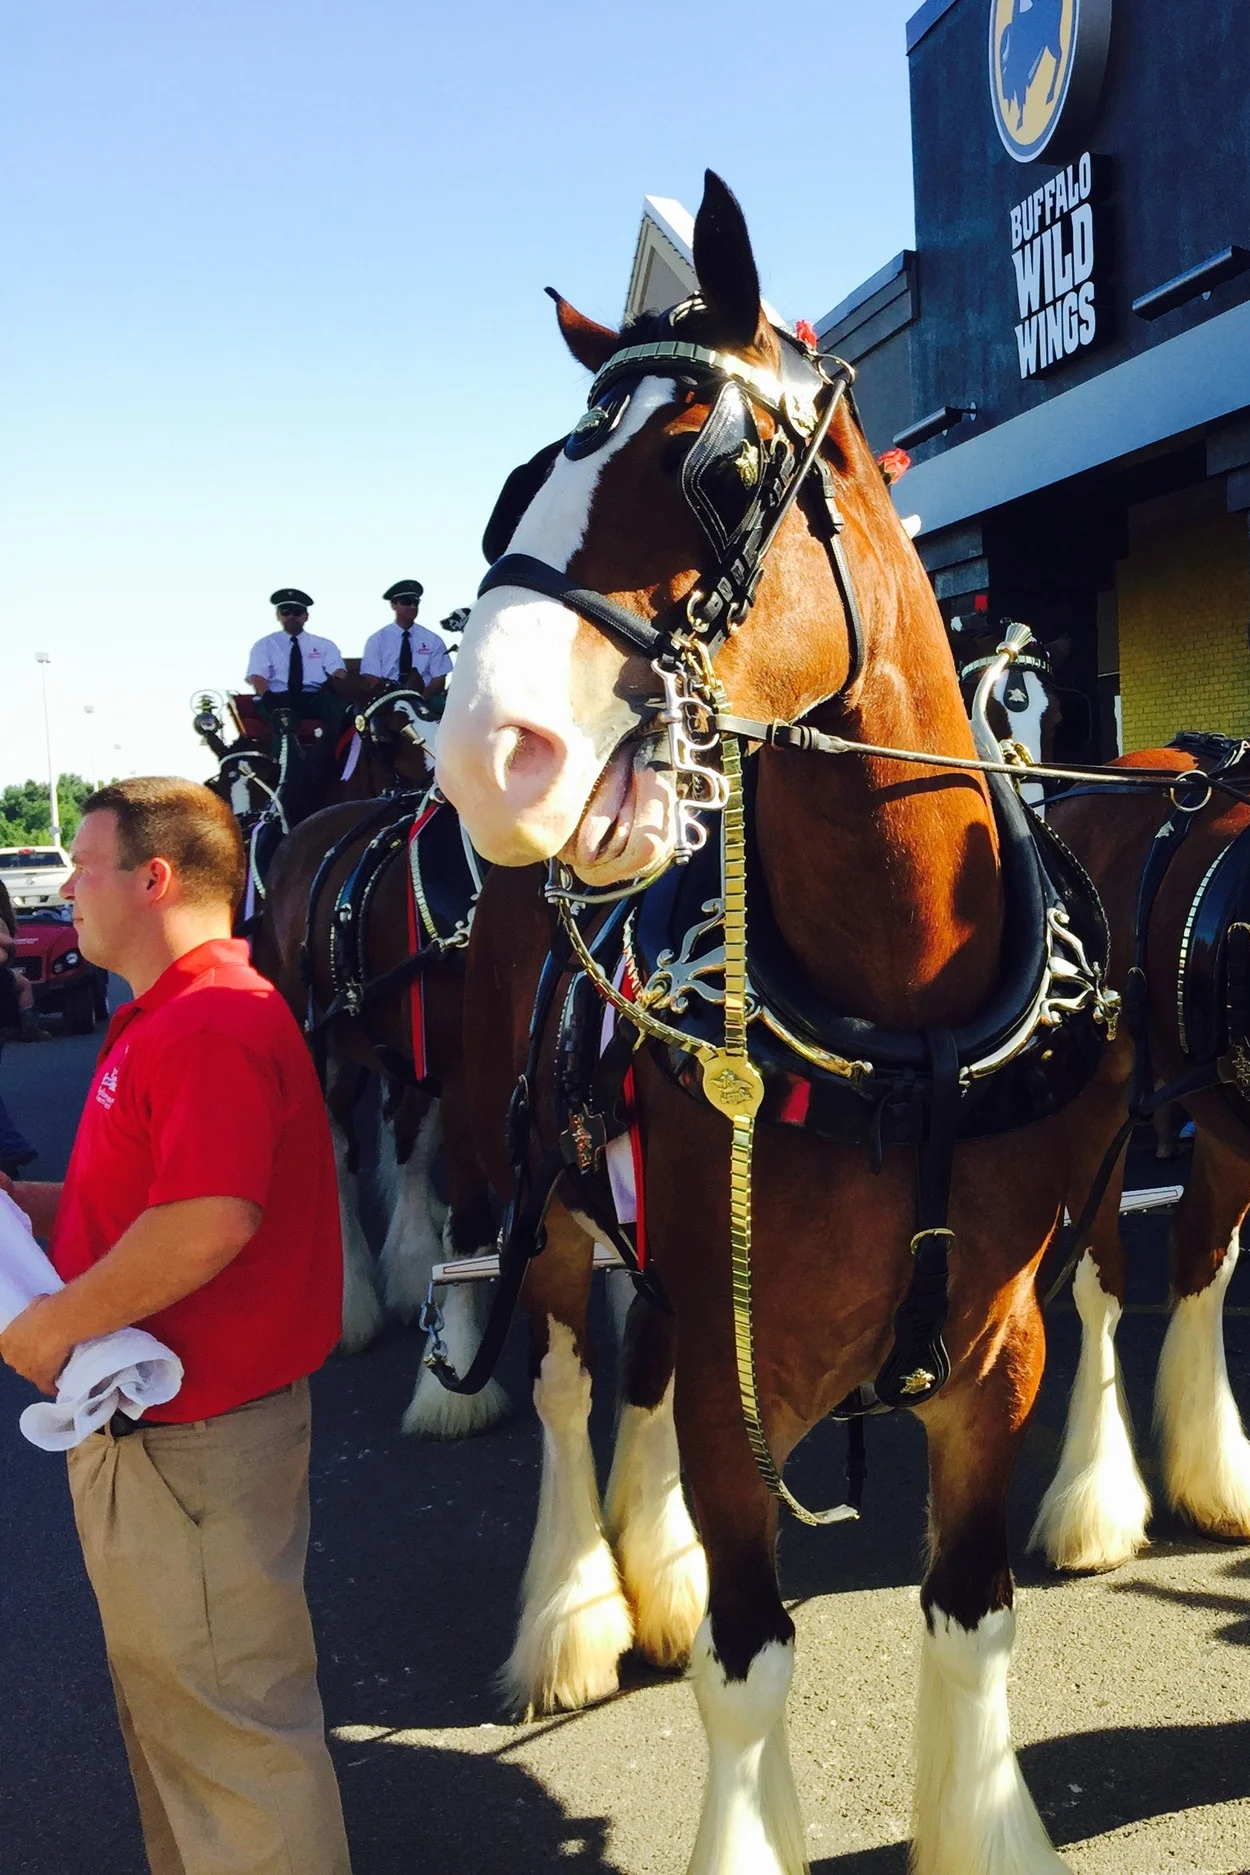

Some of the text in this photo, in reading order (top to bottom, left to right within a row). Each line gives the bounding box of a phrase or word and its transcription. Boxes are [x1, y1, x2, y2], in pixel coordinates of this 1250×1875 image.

[1010, 151, 1092, 250] BUFFALO
[1011, 202, 1094, 320] WILD
[1014, 281, 1096, 380] WINGS
